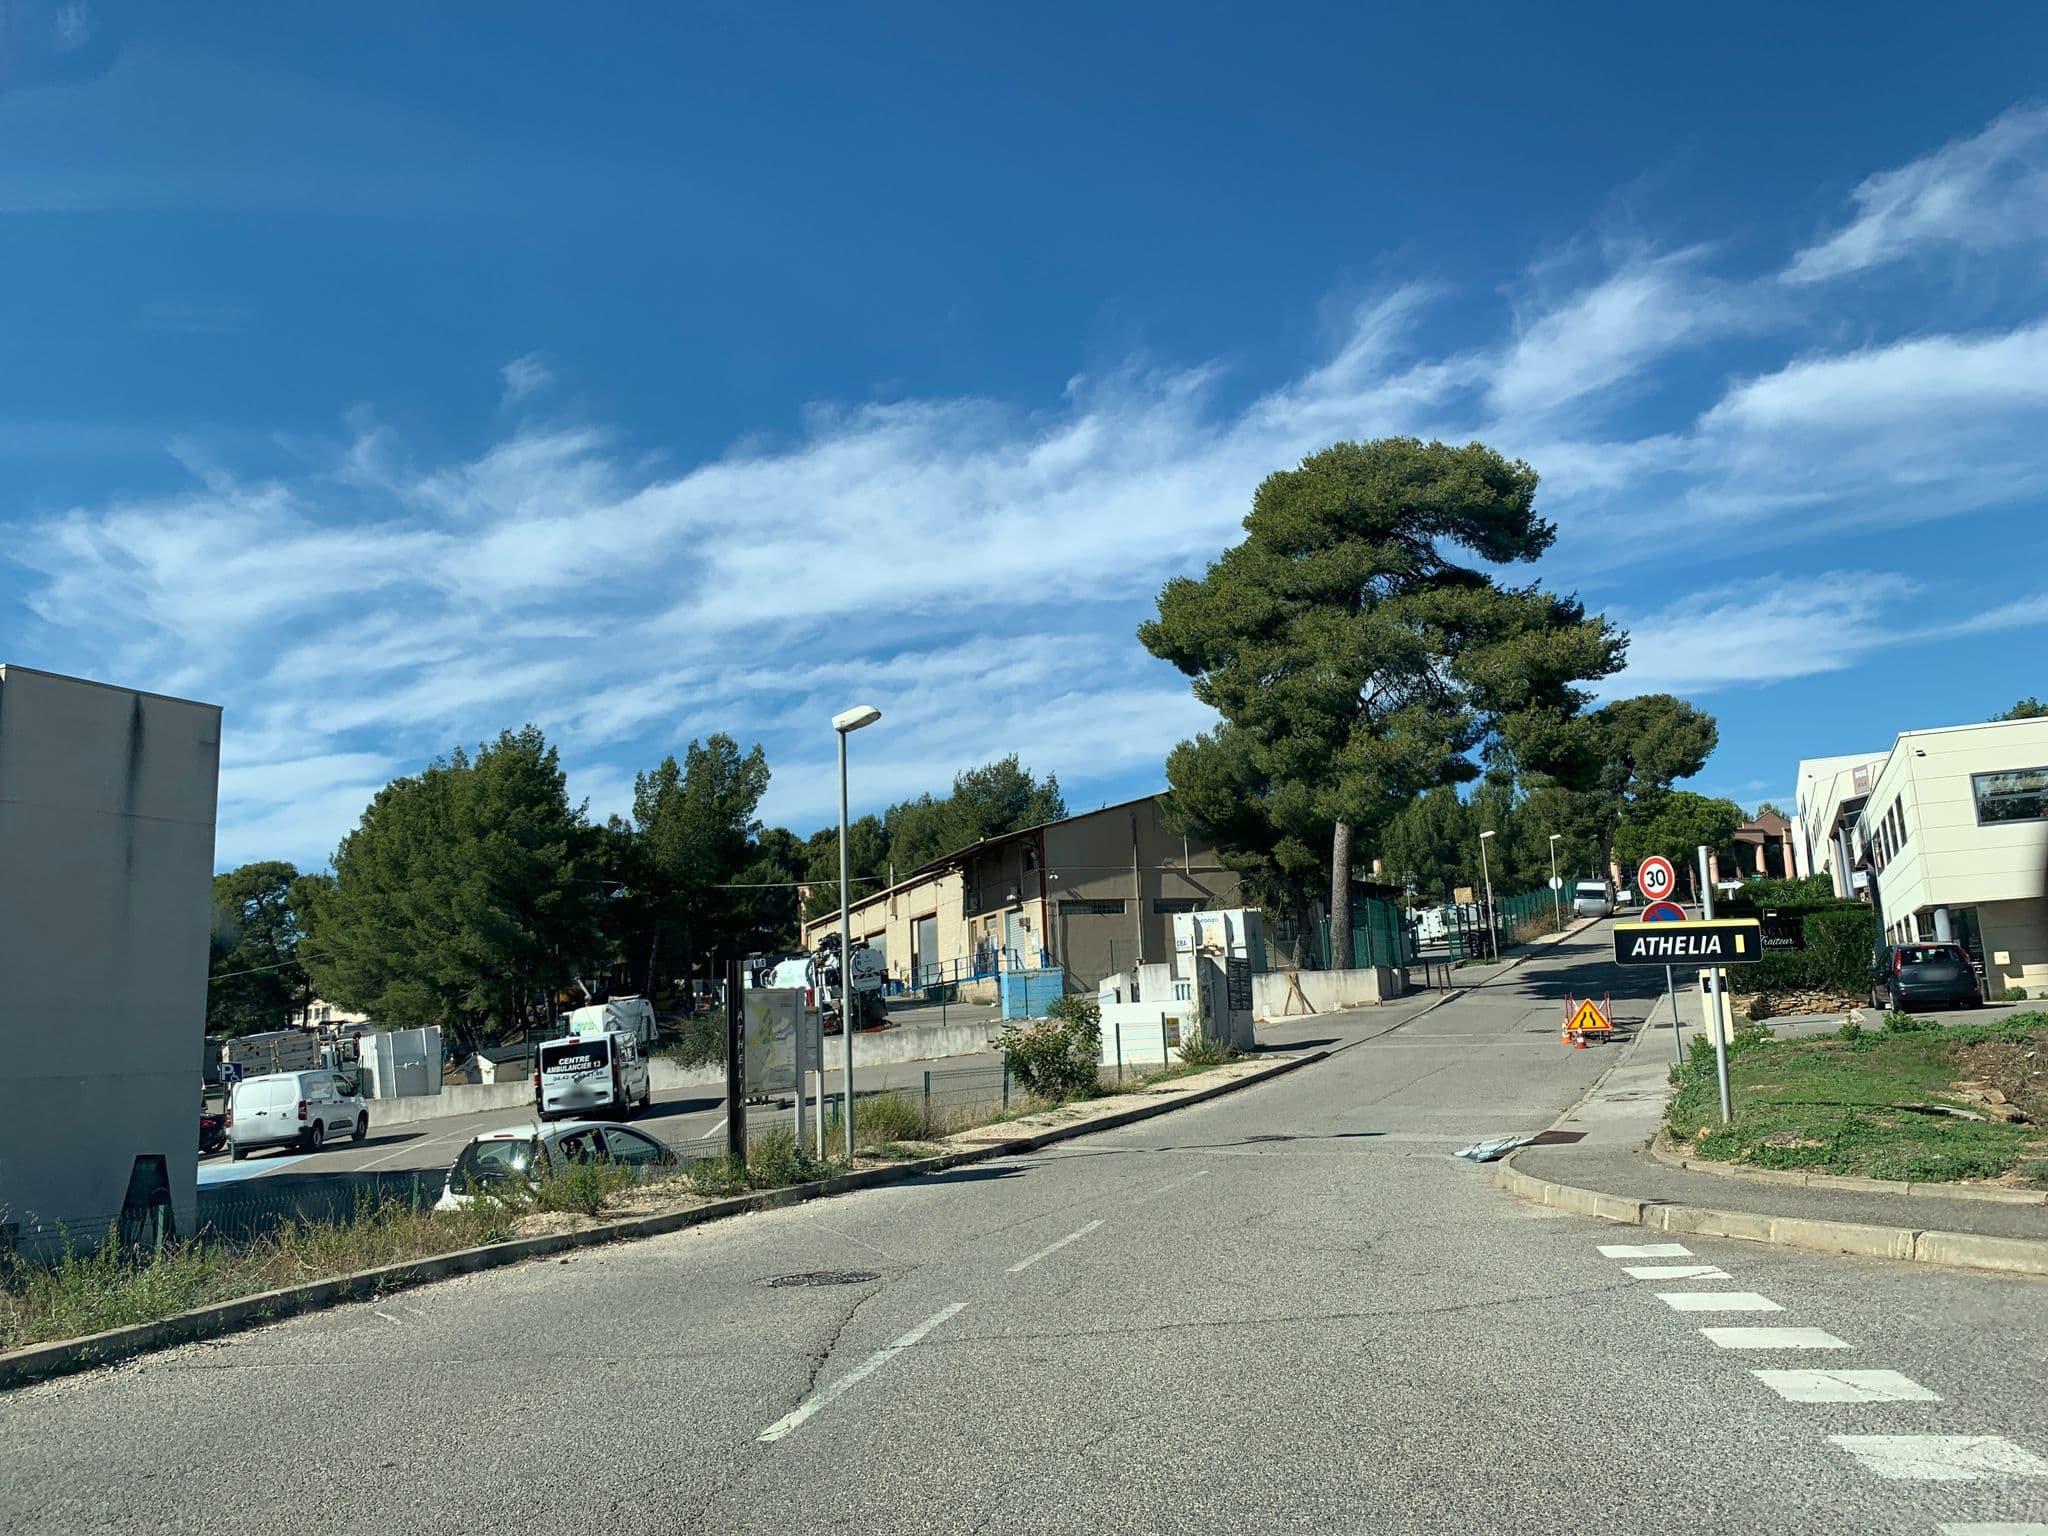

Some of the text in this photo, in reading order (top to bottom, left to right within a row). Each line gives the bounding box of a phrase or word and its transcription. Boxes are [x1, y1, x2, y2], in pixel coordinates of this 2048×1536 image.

[1646, 869, 1666, 888] 30
[1631, 935, 1722, 957] ATHELIA
[546, 1060, 601, 1073] AMBULANCIER 13
[558, 1055, 591, 1065] CENTRE
[737, 1010, 745, 1109] ATHELIA
[221, 1063, 235, 1080] P
